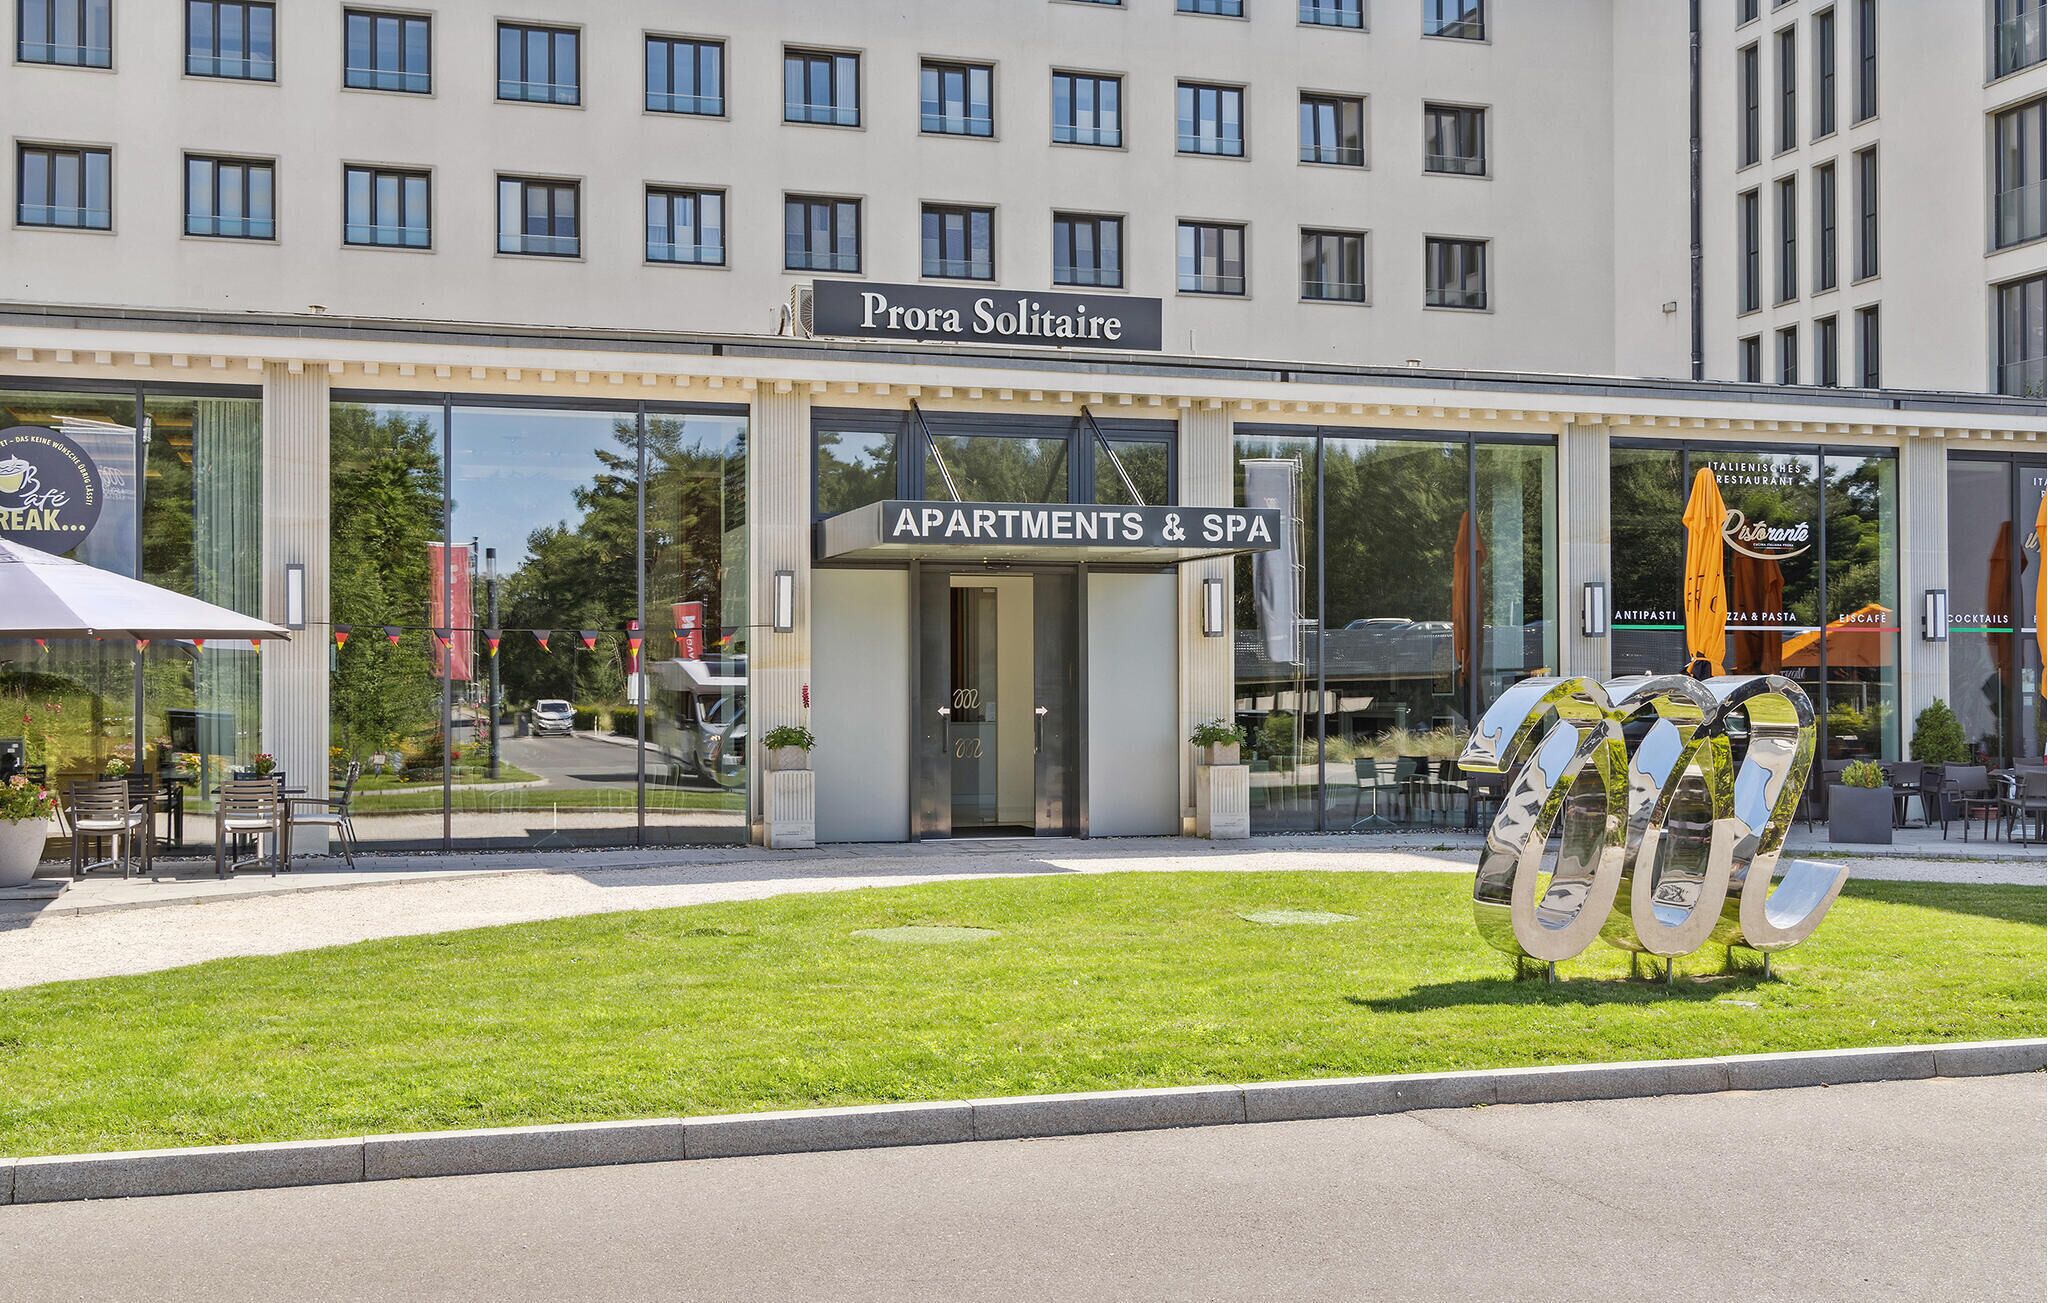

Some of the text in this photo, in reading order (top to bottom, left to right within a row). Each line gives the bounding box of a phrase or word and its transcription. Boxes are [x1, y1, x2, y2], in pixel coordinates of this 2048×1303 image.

[860, 292, 1121, 341] Prora Solitaire
[31, 436, 51, 446] KEINE
[1708, 462, 1801, 473] ITALIENISCHES
[1716, 475, 1793, 485] RESTAURANT
[893, 508, 1272, 542] APARTMENTS & SPA
[1722, 509, 1810, 555] Ristorante
[1614, 610, 1676, 620] ANTIPASTI
[1751, 612, 1759, 621] &
[1761, 612, 1797, 621] PASTA
[1948, 614, 2009, 623] COCKTAILS
